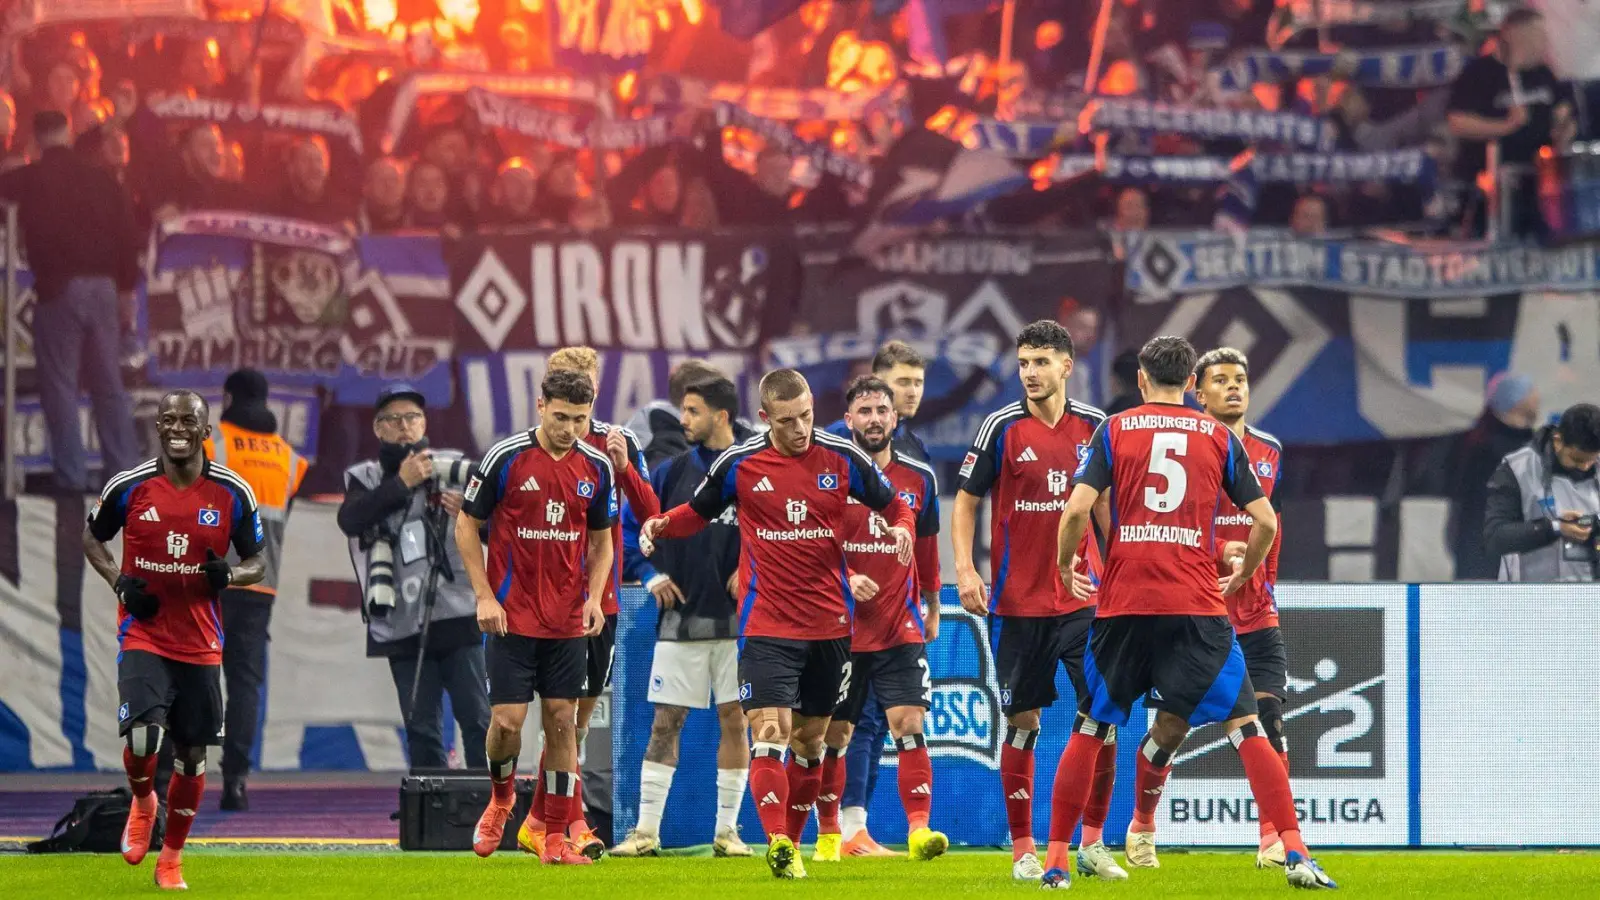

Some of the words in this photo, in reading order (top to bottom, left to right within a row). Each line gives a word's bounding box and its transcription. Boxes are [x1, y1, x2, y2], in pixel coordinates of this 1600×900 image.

[531, 240, 711, 350] IRON
[1121, 415, 1198, 431] HAMBURGER
[1200, 419, 1215, 436] SV
[233, 436, 284, 455] BEST
[1145, 432, 1187, 513] 5
[1015, 499, 1069, 511] HanseM
[756, 527, 834, 541] HanseMerku
[1317, 694, 1373, 768] 2
